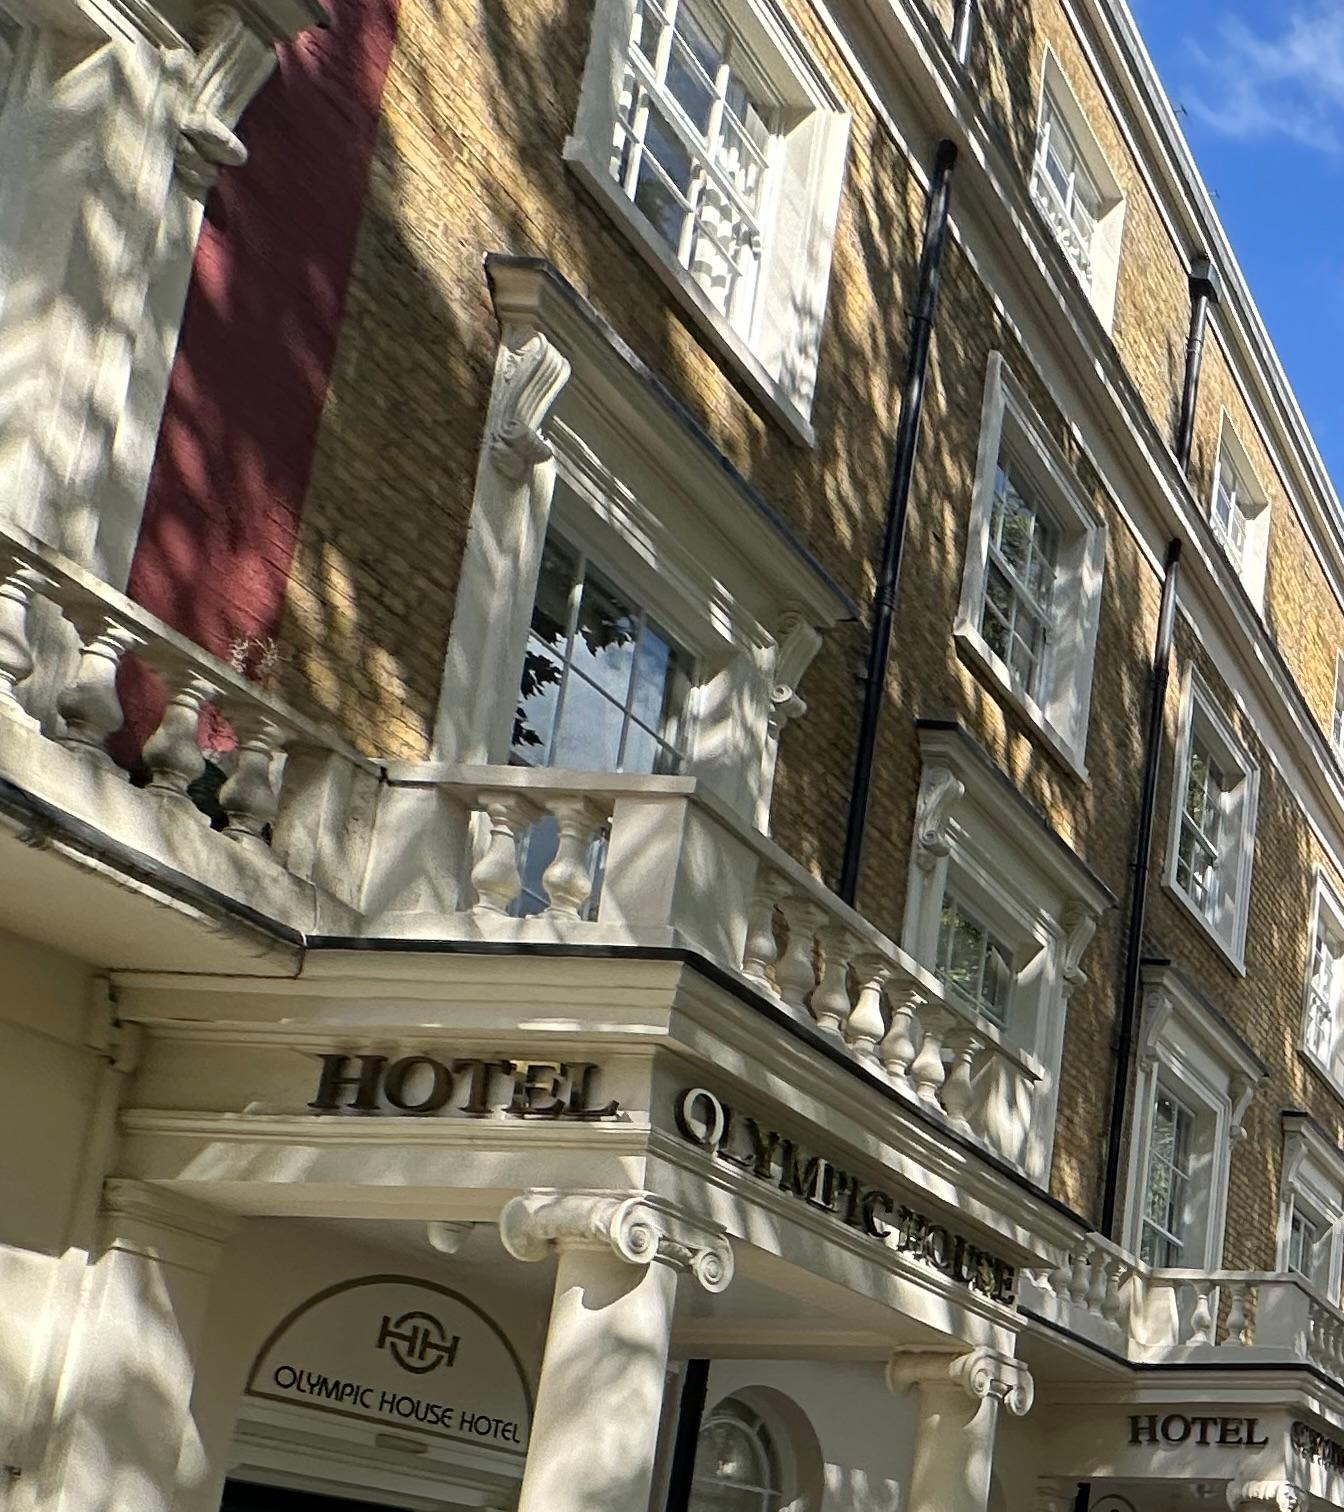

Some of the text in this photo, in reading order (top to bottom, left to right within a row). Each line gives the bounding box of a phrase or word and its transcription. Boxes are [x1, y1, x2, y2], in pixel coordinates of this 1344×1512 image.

[309, 1053, 620, 1122] HOTEL
[274, 1365, 521, 1443] OLYMPIC HOUSE HOTEL
[1127, 1413, 1269, 1446] HOTEL
